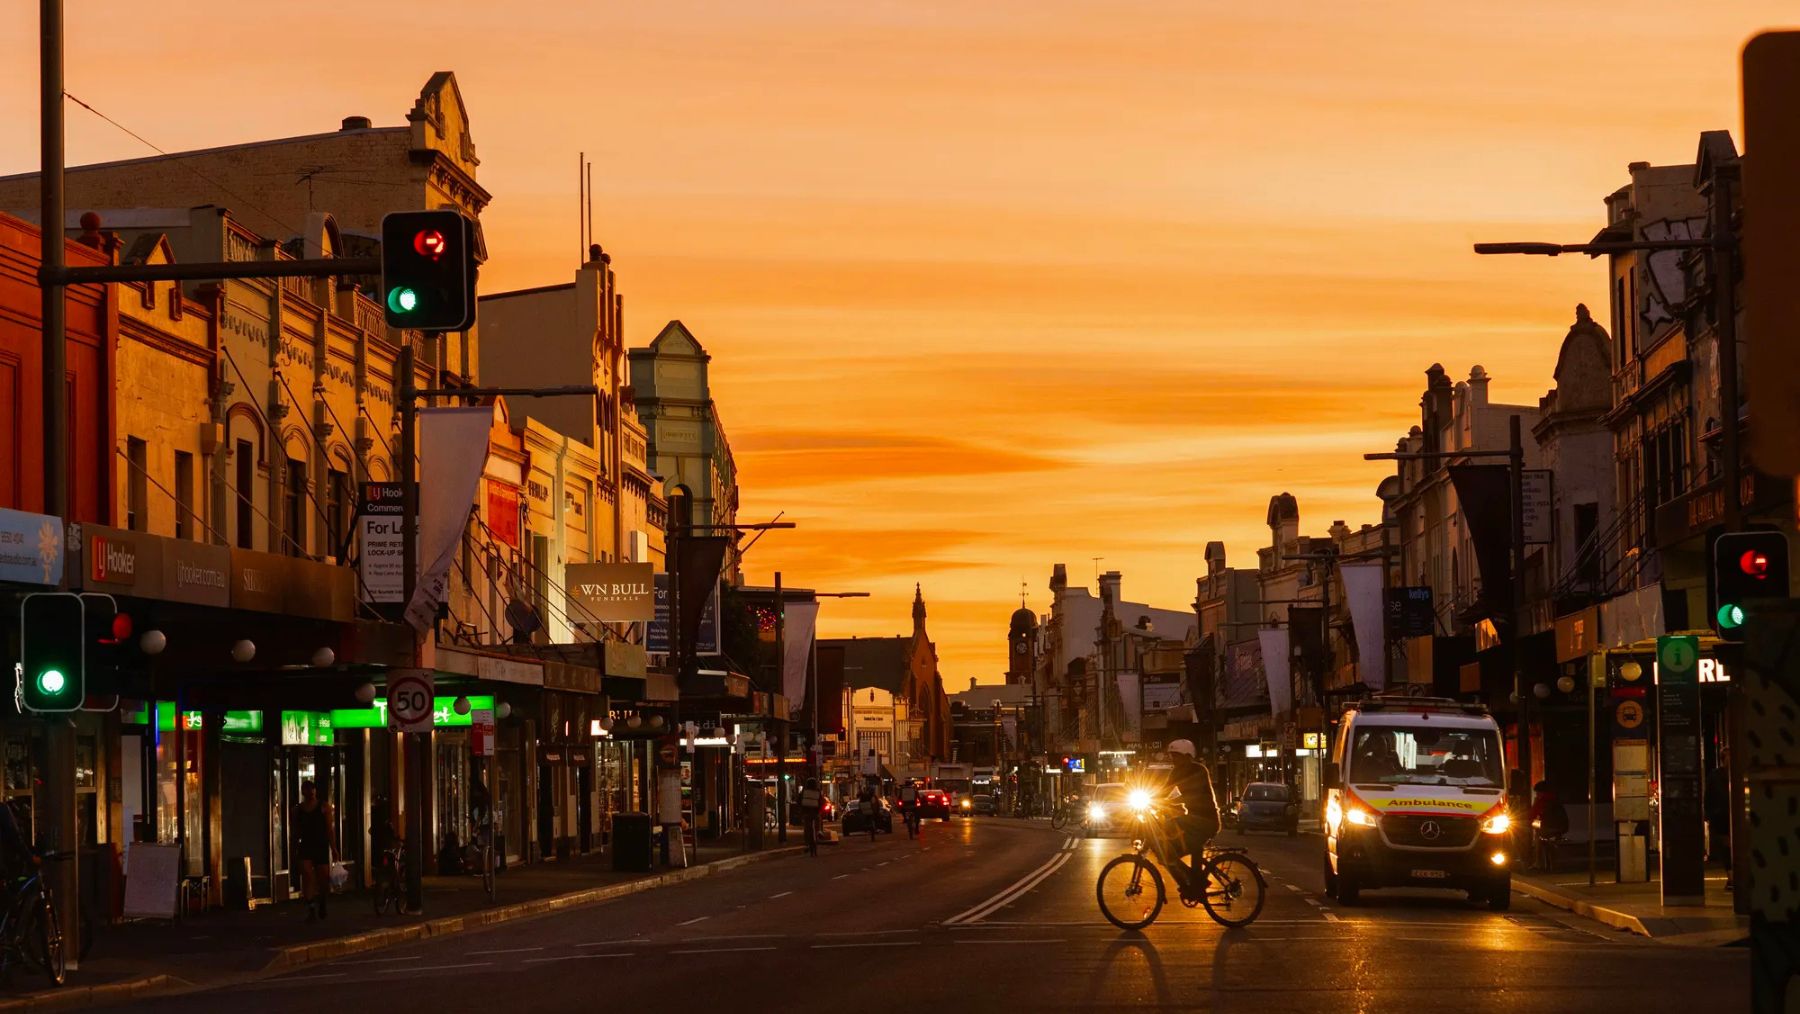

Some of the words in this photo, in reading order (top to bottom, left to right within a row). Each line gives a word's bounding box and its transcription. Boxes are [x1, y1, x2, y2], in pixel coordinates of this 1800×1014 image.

[382, 487, 404, 498] Hook
[367, 520, 389, 535] For
[106, 542, 136, 575] Hooker
[176, 558, 226, 589] ljhooker.com.au
[580, 584, 608, 596] WN
[611, 583, 649, 596] BULL
[396, 691, 426, 712] 50
[1387, 799, 1473, 809] Ambulance
